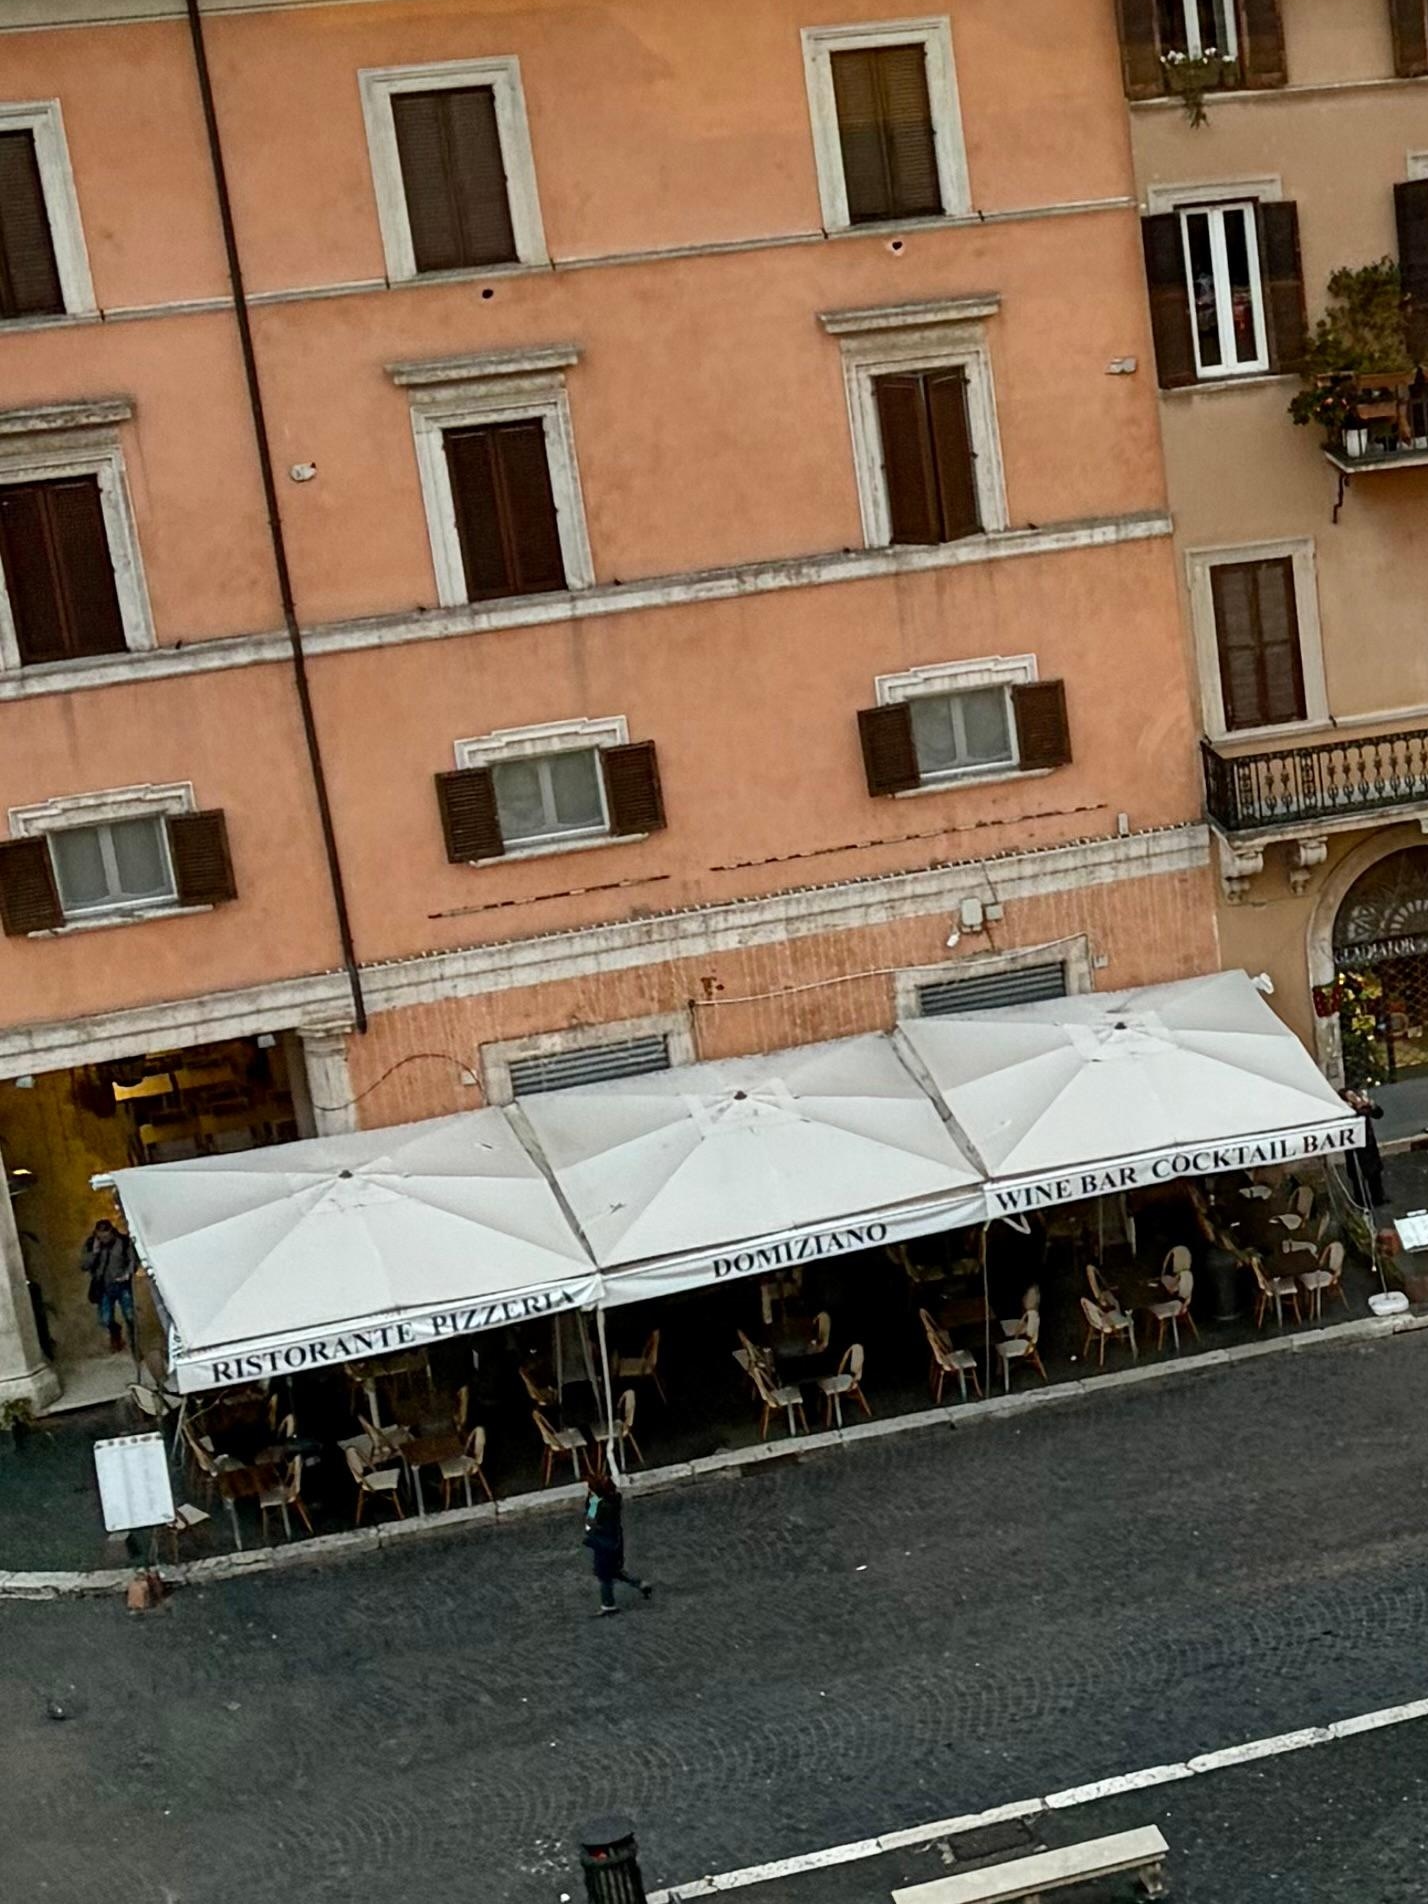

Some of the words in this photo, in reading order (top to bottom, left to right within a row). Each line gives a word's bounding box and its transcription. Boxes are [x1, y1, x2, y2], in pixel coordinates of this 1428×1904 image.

[995, 1178, 1073, 1211] WINE
[1081, 1166, 1138, 1195] BAR
[1151, 1139, 1297, 1178] COCKTAIL
[1303, 1126, 1356, 1153] BAR
[713, 1222, 888, 1278] DOMIZIANO
[211, 1321, 417, 1383] RISTORANTE
[431, 1289, 575, 1337] PIZZERIA
